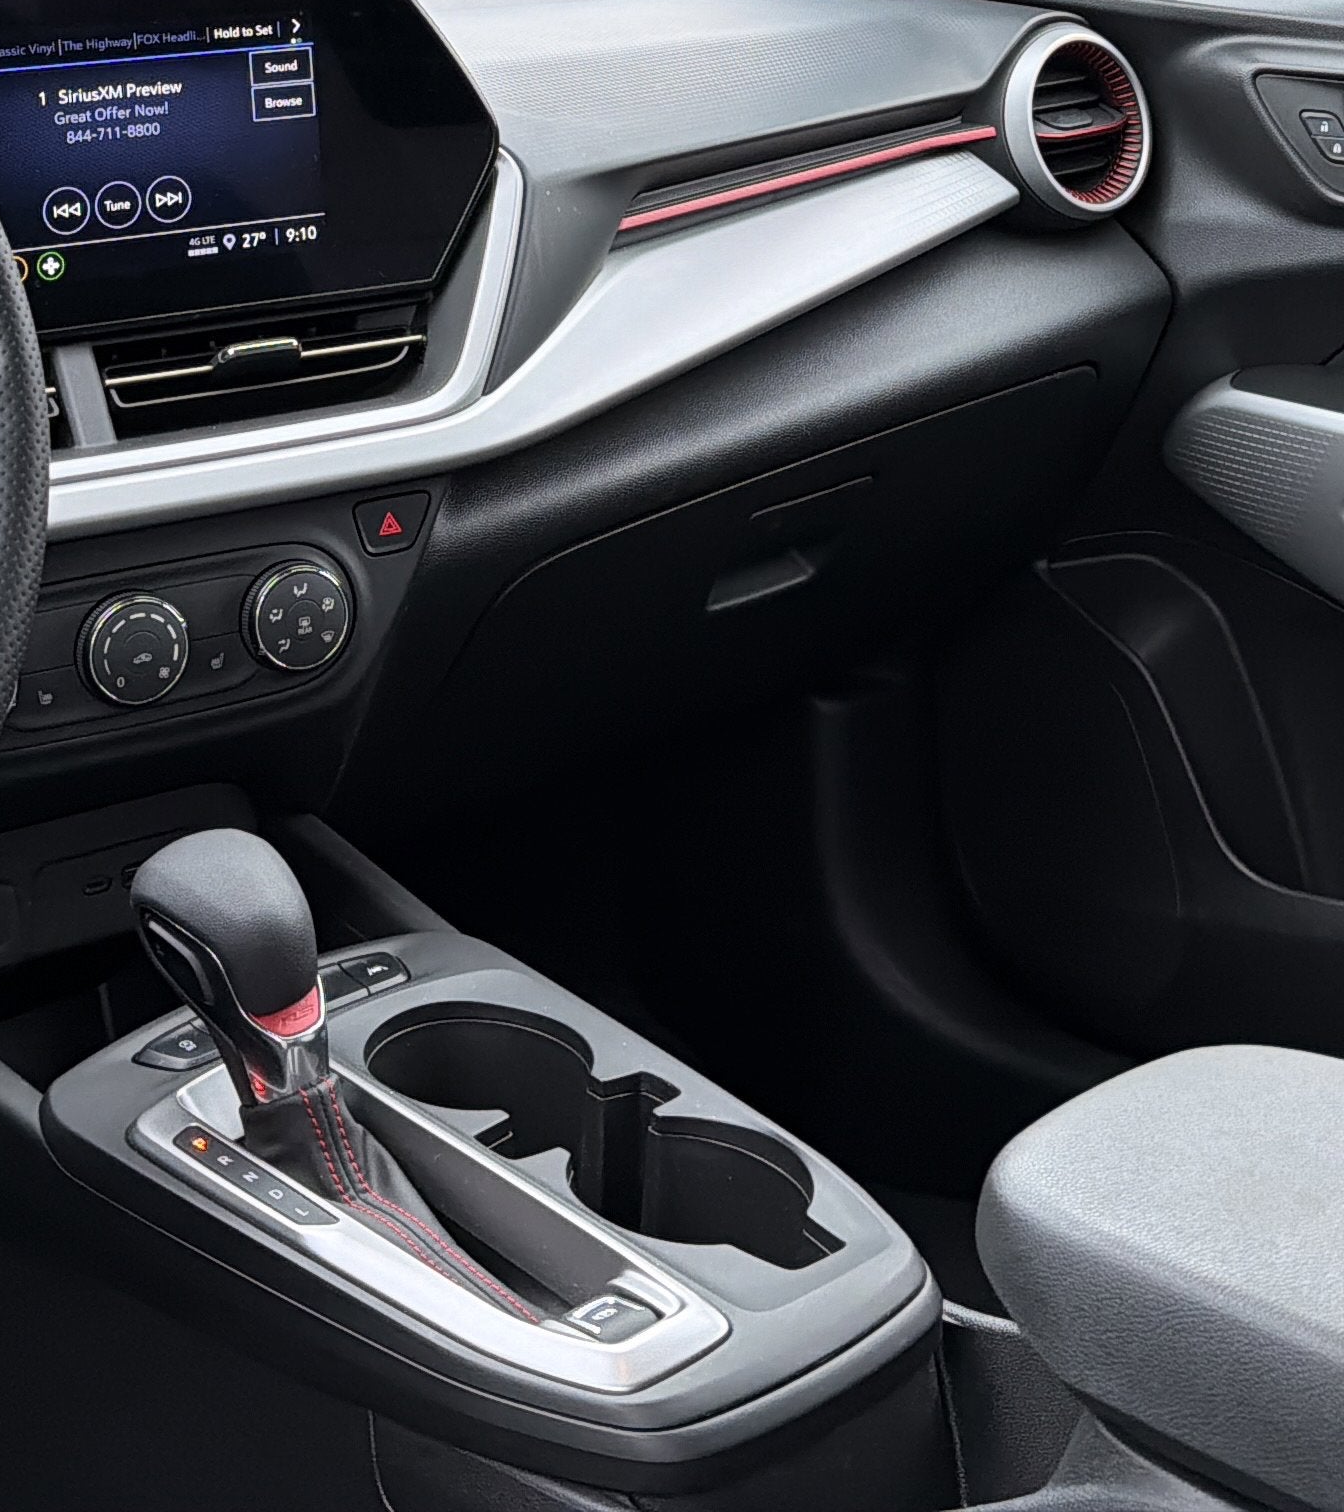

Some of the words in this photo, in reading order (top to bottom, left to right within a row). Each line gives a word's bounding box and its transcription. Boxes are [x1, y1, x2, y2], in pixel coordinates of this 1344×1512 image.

[137, 33, 160, 45] FOX
[214, 25, 240, 39] Hold
[242, 27, 254, 38] to
[255, 25, 273, 37] Set
[28, 42, 55, 56] Vinyl
[62, 40, 83, 52] The
[86, 36, 133, 53] Highway
[264, 60, 298, 74] Sound
[39, 91, 46, 106] 1
[58, 84, 123, 105] SiriusXM
[127, 81, 182, 98] Preview
[264, 96, 303, 109] Browse
[54, 110, 92, 126] Great
[94, 105, 131, 121] Offer
[134, 101, 169, 118] Now!
[66, 122, 161, 144] 844-711-8800
[104, 199, 131, 212] Tune
[286, 226, 317, 242] 9:10
[216, 1155, 234, 1166] R
[242, 1171, 259, 1183] N
[268, 1189, 284, 1200] D
[294, 1207, 309, 1217] L
